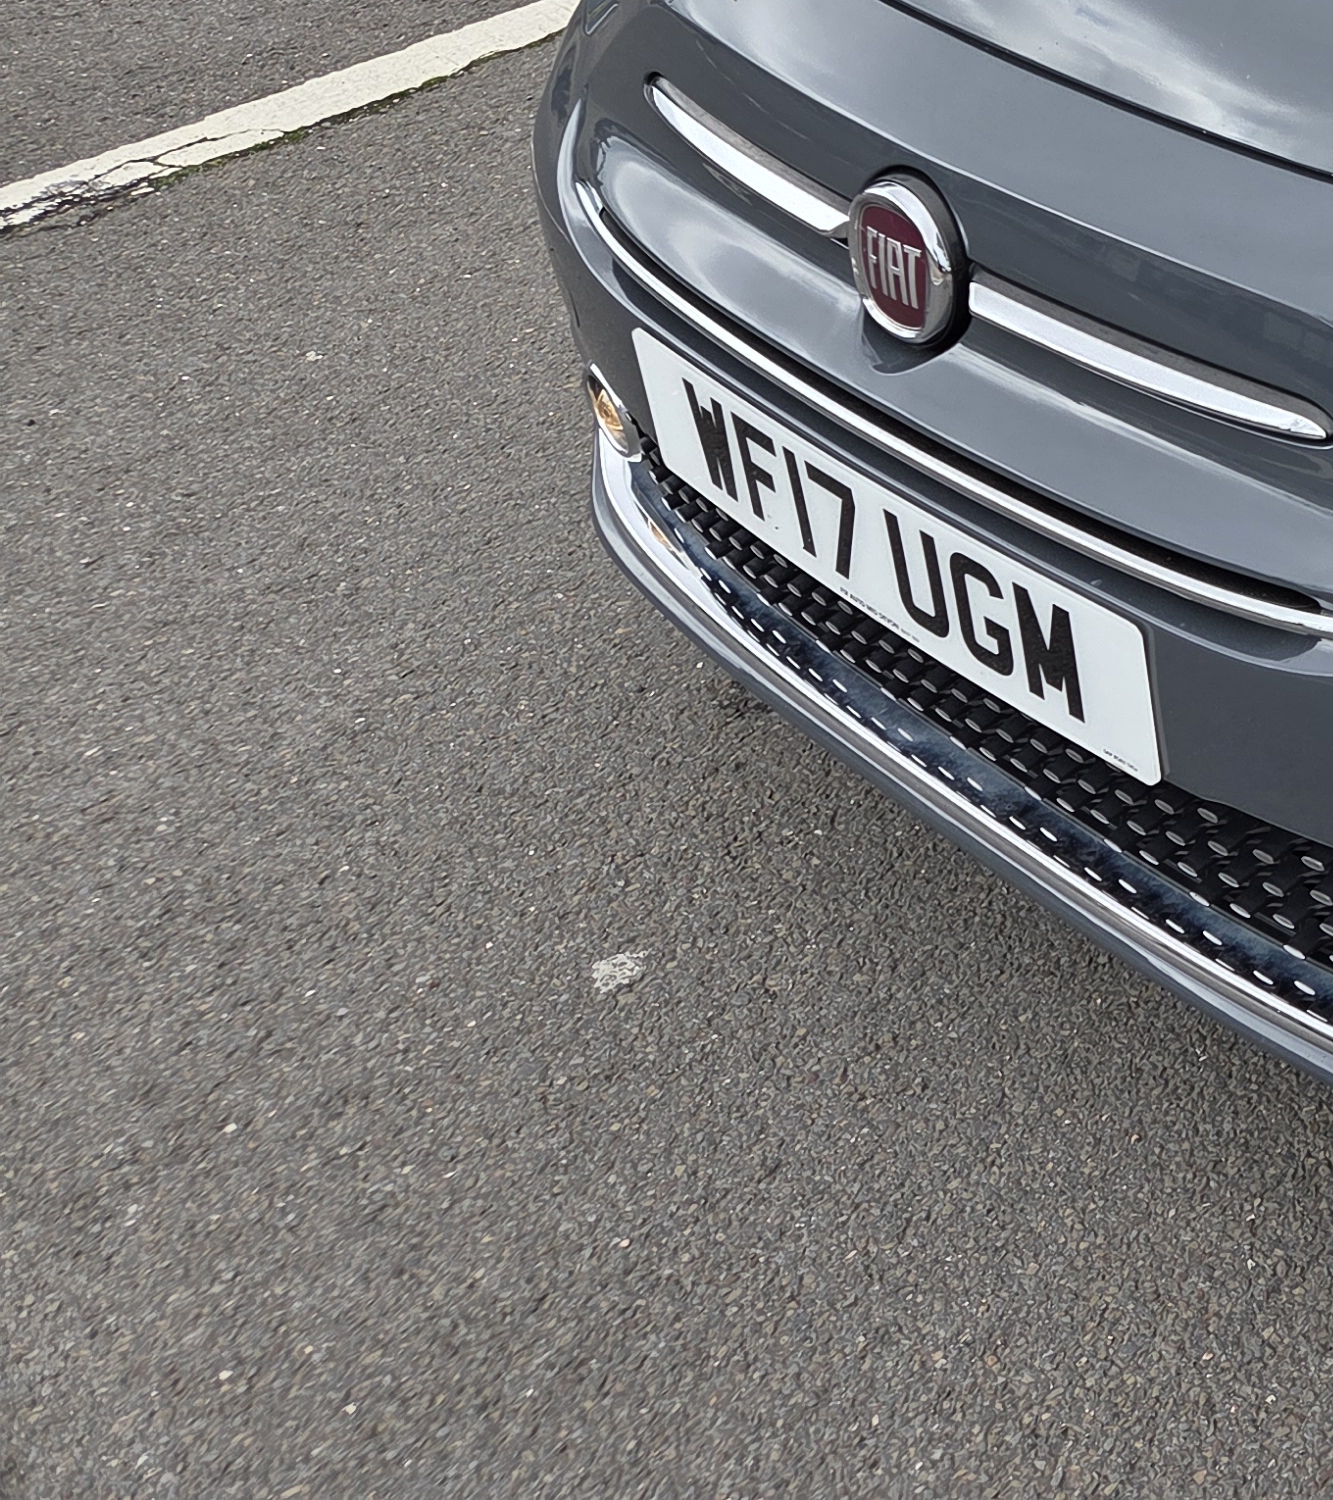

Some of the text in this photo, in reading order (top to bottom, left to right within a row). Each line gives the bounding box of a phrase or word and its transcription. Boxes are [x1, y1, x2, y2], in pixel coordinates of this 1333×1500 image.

[866, 225, 922, 310] FIAT
[682, 377, 1086, 724] WF17 UGM
